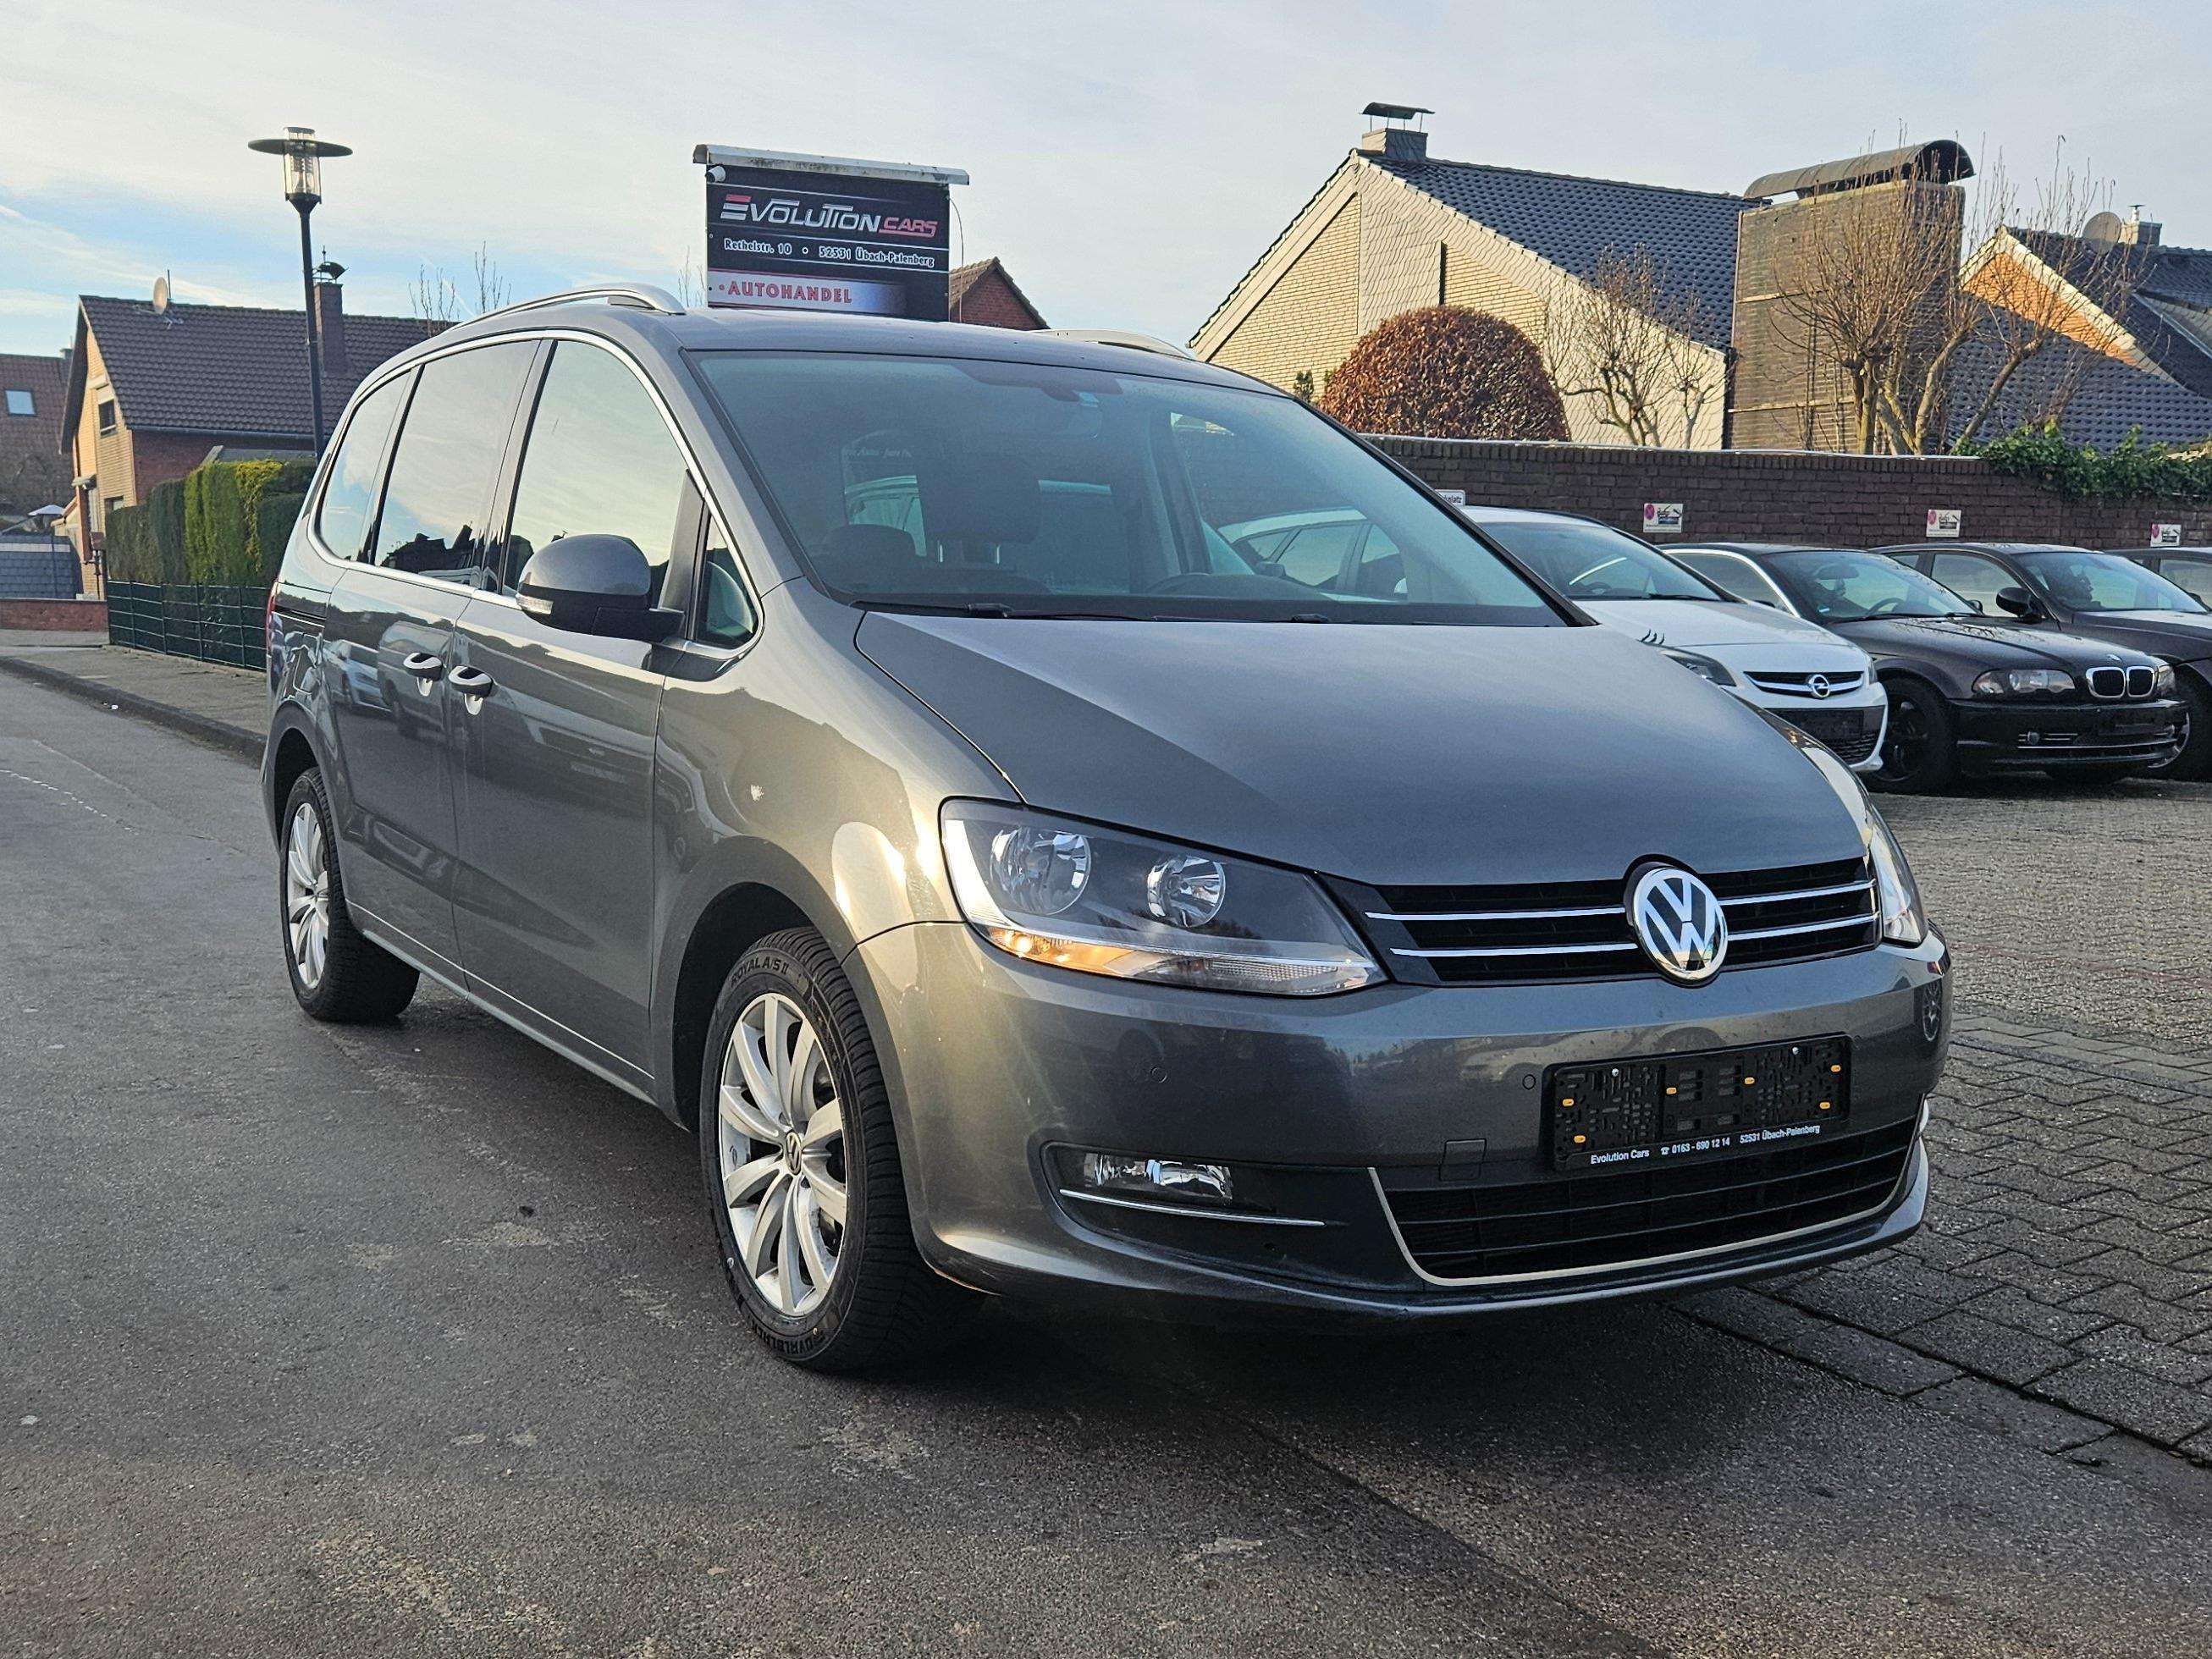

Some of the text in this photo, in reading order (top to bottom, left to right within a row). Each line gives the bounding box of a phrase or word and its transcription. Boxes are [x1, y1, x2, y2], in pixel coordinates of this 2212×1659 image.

[720, 194, 938, 237] EVOLUTION CARS
[724, 238, 935, 267] Rethelstr. 10 52531 Übach-Palenberg
[728, 280, 852, 303] AUTOHANDEL
[1591, 1152, 1630, 1165] Evolution
[1630, 1149, 1650, 1159] Cars
[1740, 1133, 1761, 1144] 52531
